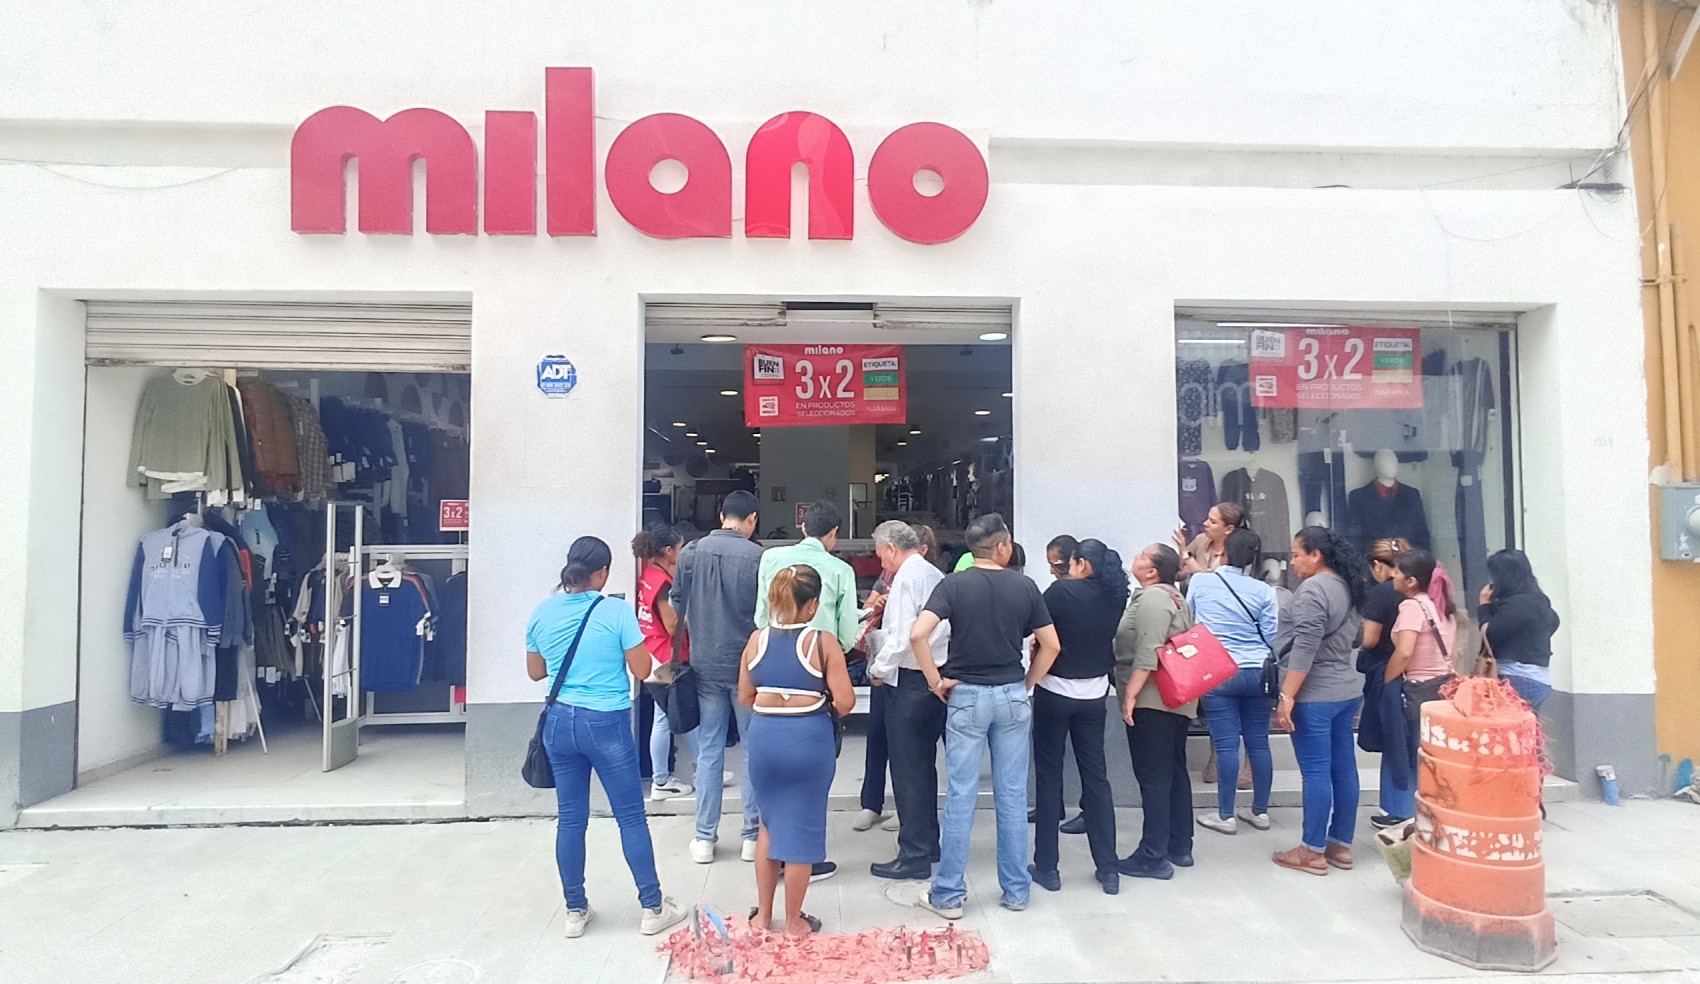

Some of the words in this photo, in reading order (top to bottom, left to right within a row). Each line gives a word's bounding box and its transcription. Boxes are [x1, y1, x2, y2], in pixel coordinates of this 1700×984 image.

[291, 67, 989, 244] milano
[1256, 335, 1280, 344] BUEN
[805, 345, 844, 355] milano
[758, 358, 779, 367] BUEN
[541, 364, 571, 380] ADT
[808, 401, 855, 409] PRODUCTOS
